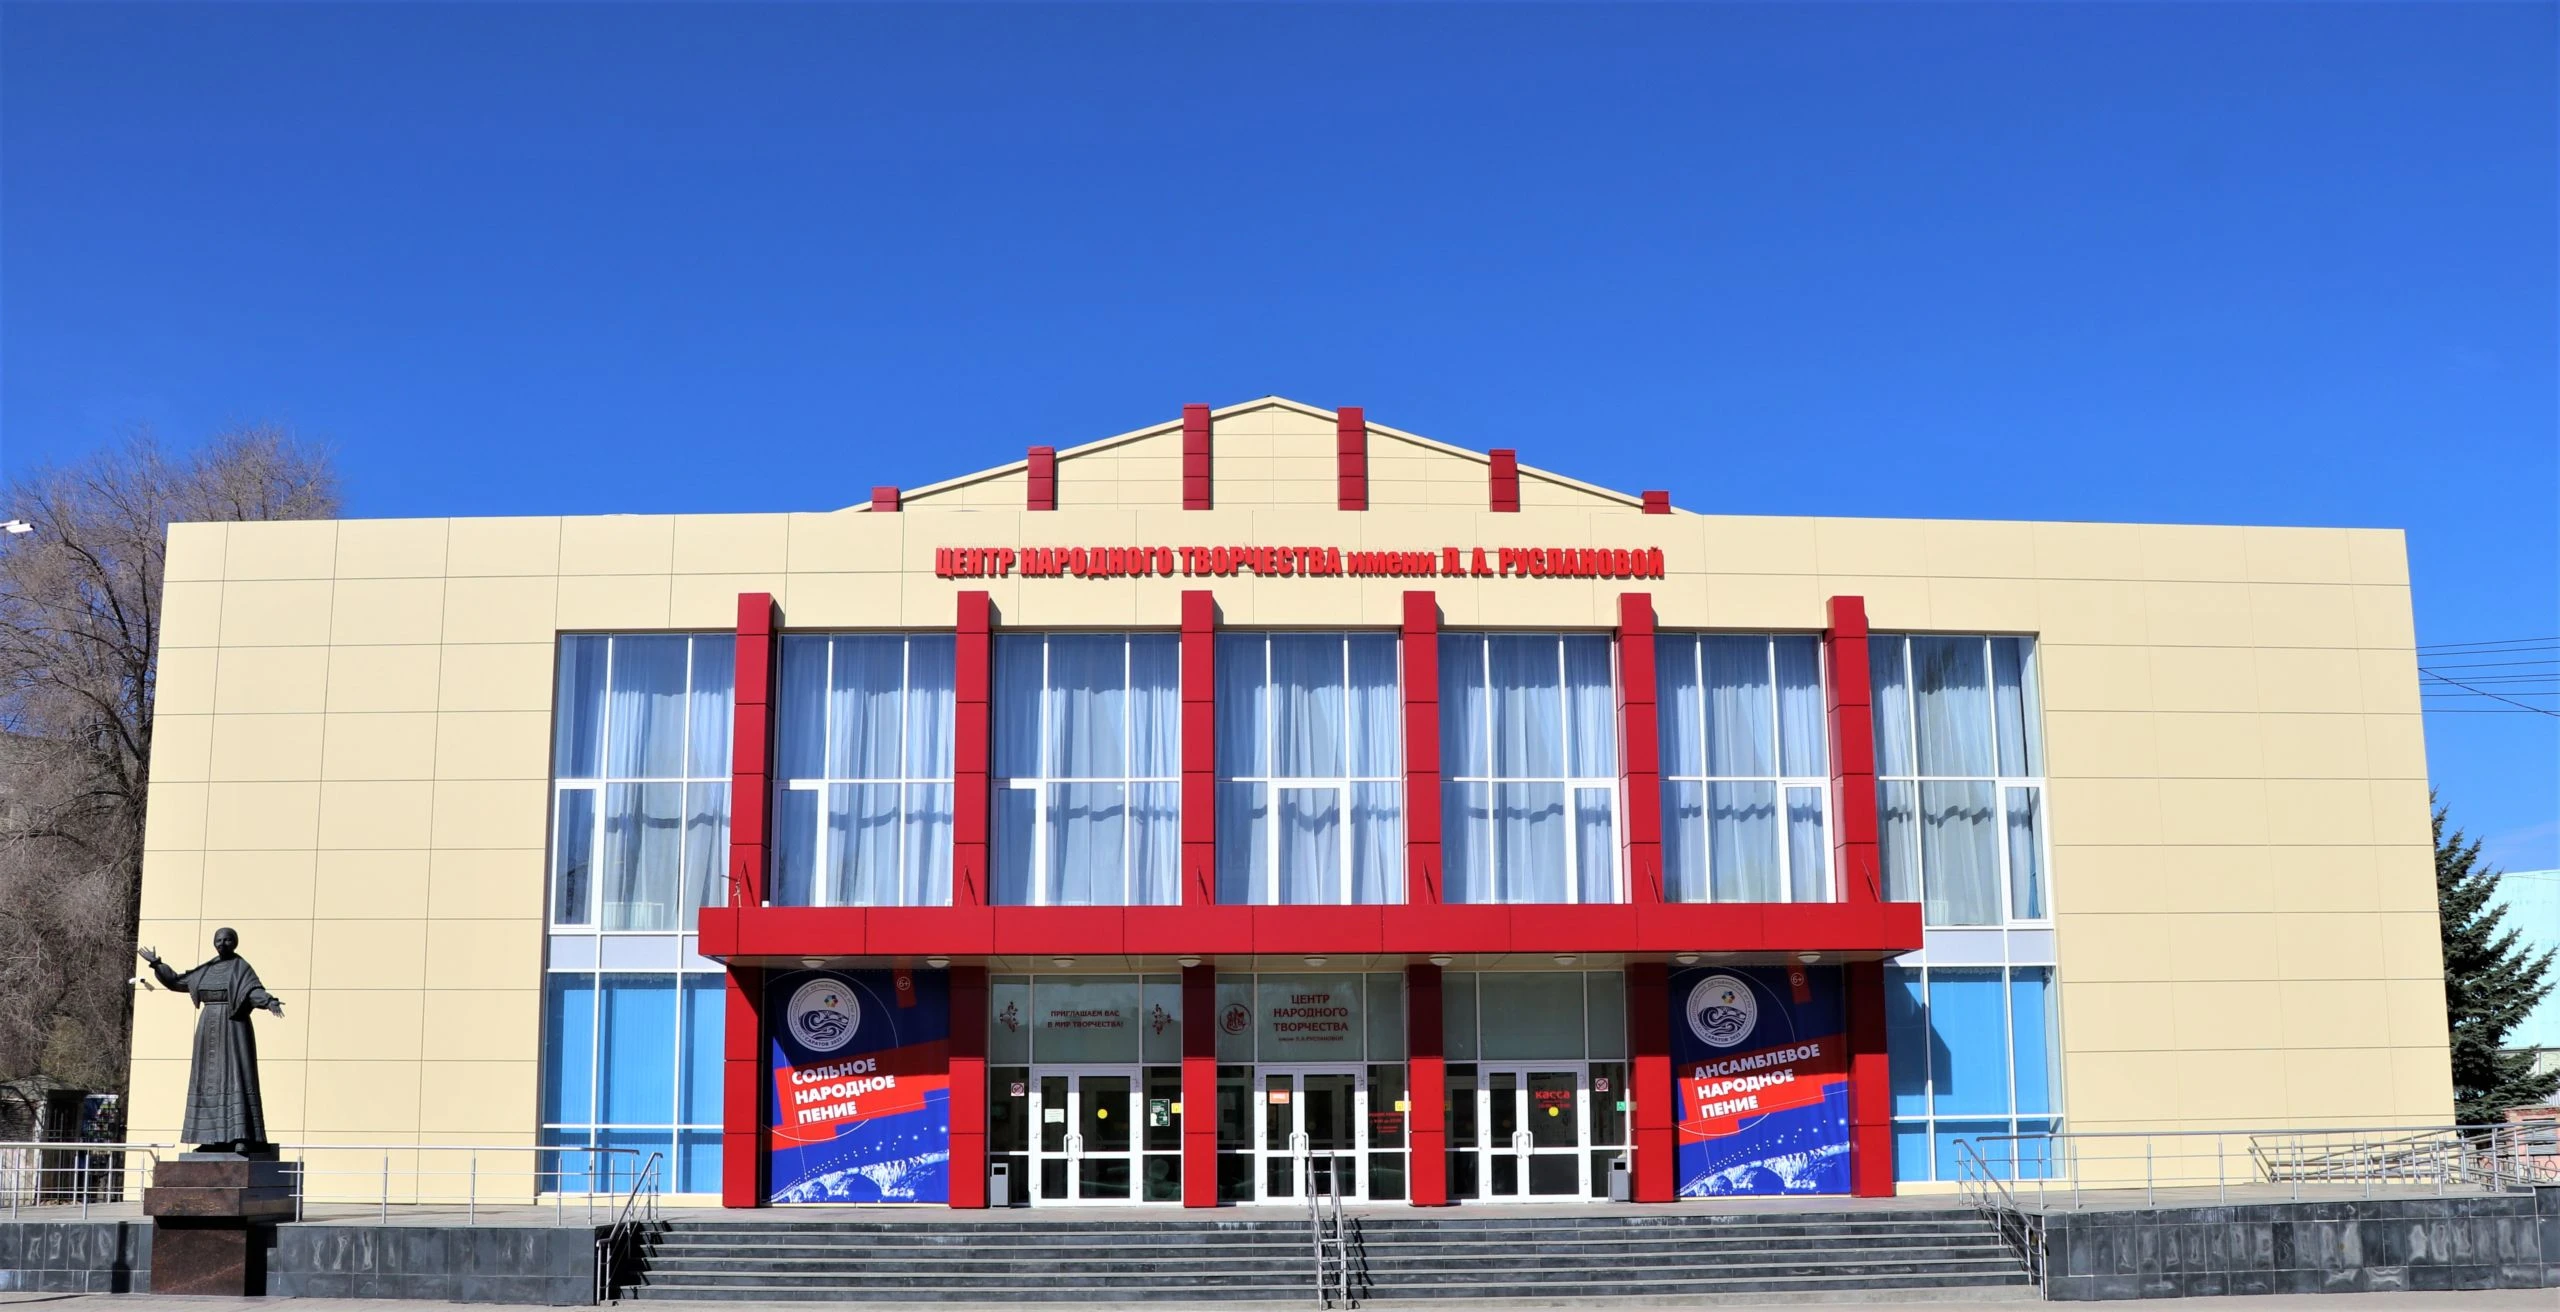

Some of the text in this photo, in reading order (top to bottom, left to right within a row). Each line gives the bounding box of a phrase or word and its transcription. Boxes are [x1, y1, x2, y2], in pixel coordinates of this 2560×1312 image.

[936, 546, 1664, 579] ЦЕНТР НАРОДНОГО ТВОРЧЕСТВА имени Л. А. РУСЛАНОВОЙ
[1291, 994, 1330, 1004] ЦЕНТР
[1273, 1008, 1348, 1018] НАРОДНОГО
[1273, 1022, 1348, 1032] ТВОРЧЕСТВА
[792, 1058, 877, 1086] СОЛЬНОЕ
[1694, 1044, 1820, 1080] АНСАМБЛЕВОЕ
[794, 1075, 896, 1104] НАРОДНОЕ
[1536, 1090, 1570, 1099] касса
[1697, 1068, 1794, 1100] НАРОДНОЕ
[798, 1101, 857, 1124] ПЕНИЕ
[1701, 1096, 1758, 1118] ПЕНИЕ
